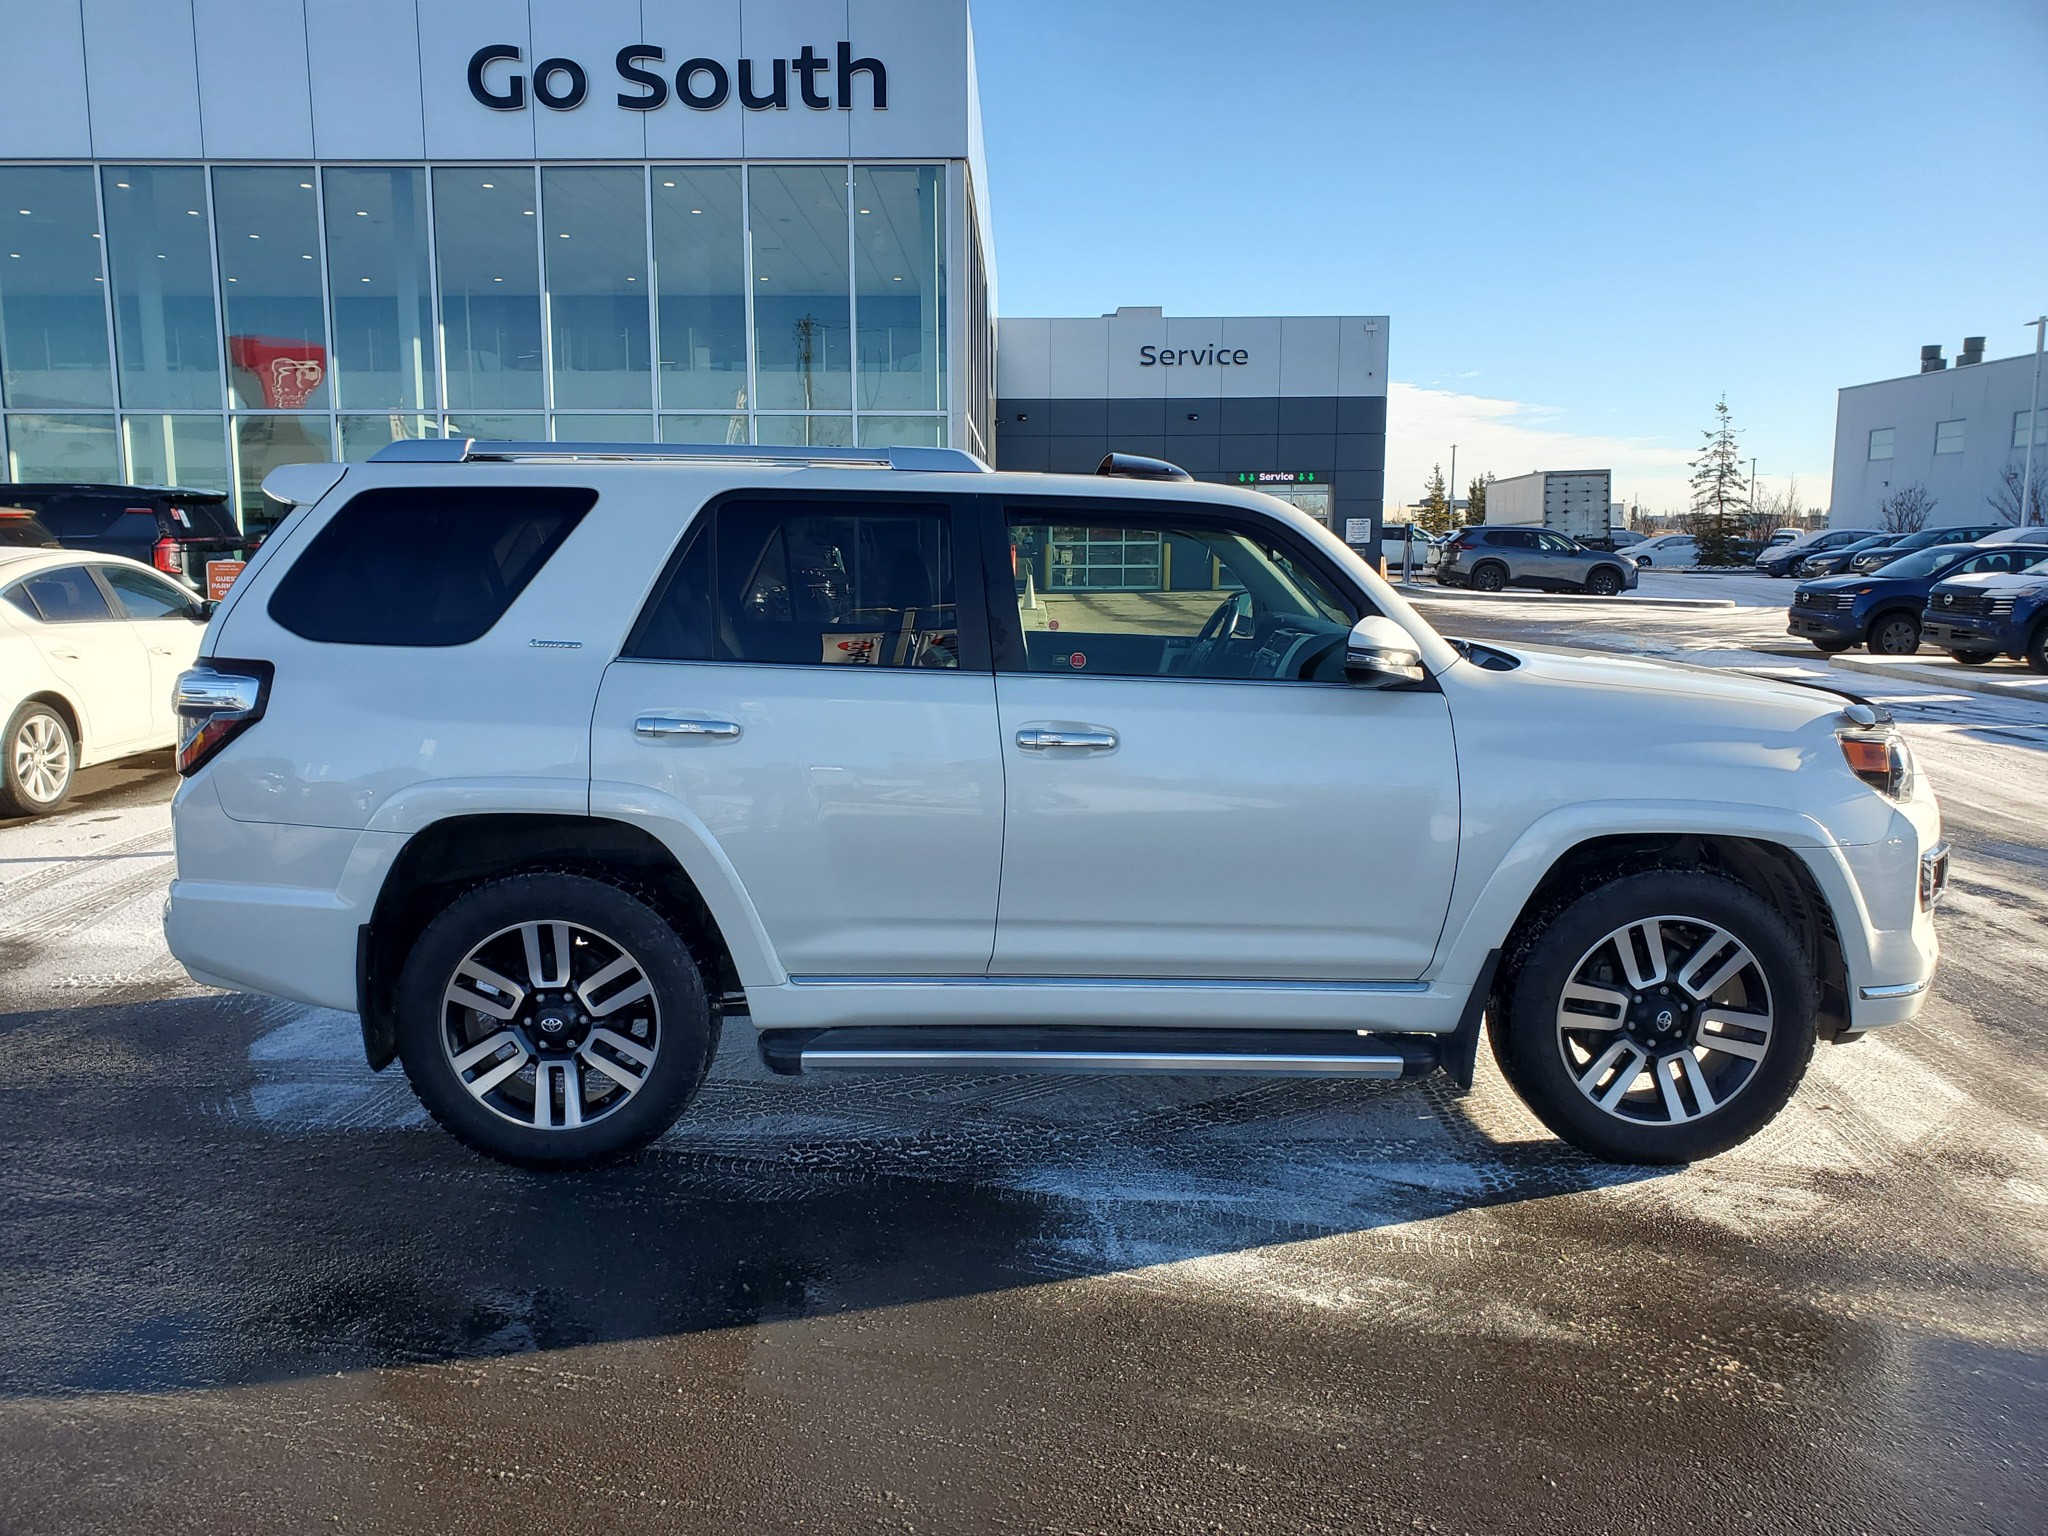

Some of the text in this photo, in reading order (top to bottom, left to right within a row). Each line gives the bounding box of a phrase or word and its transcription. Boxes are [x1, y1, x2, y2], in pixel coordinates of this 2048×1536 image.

[467, 40, 889, 111] Go South
[1140, 343, 1249, 366] Service
[1259, 472, 1294, 481] Service
